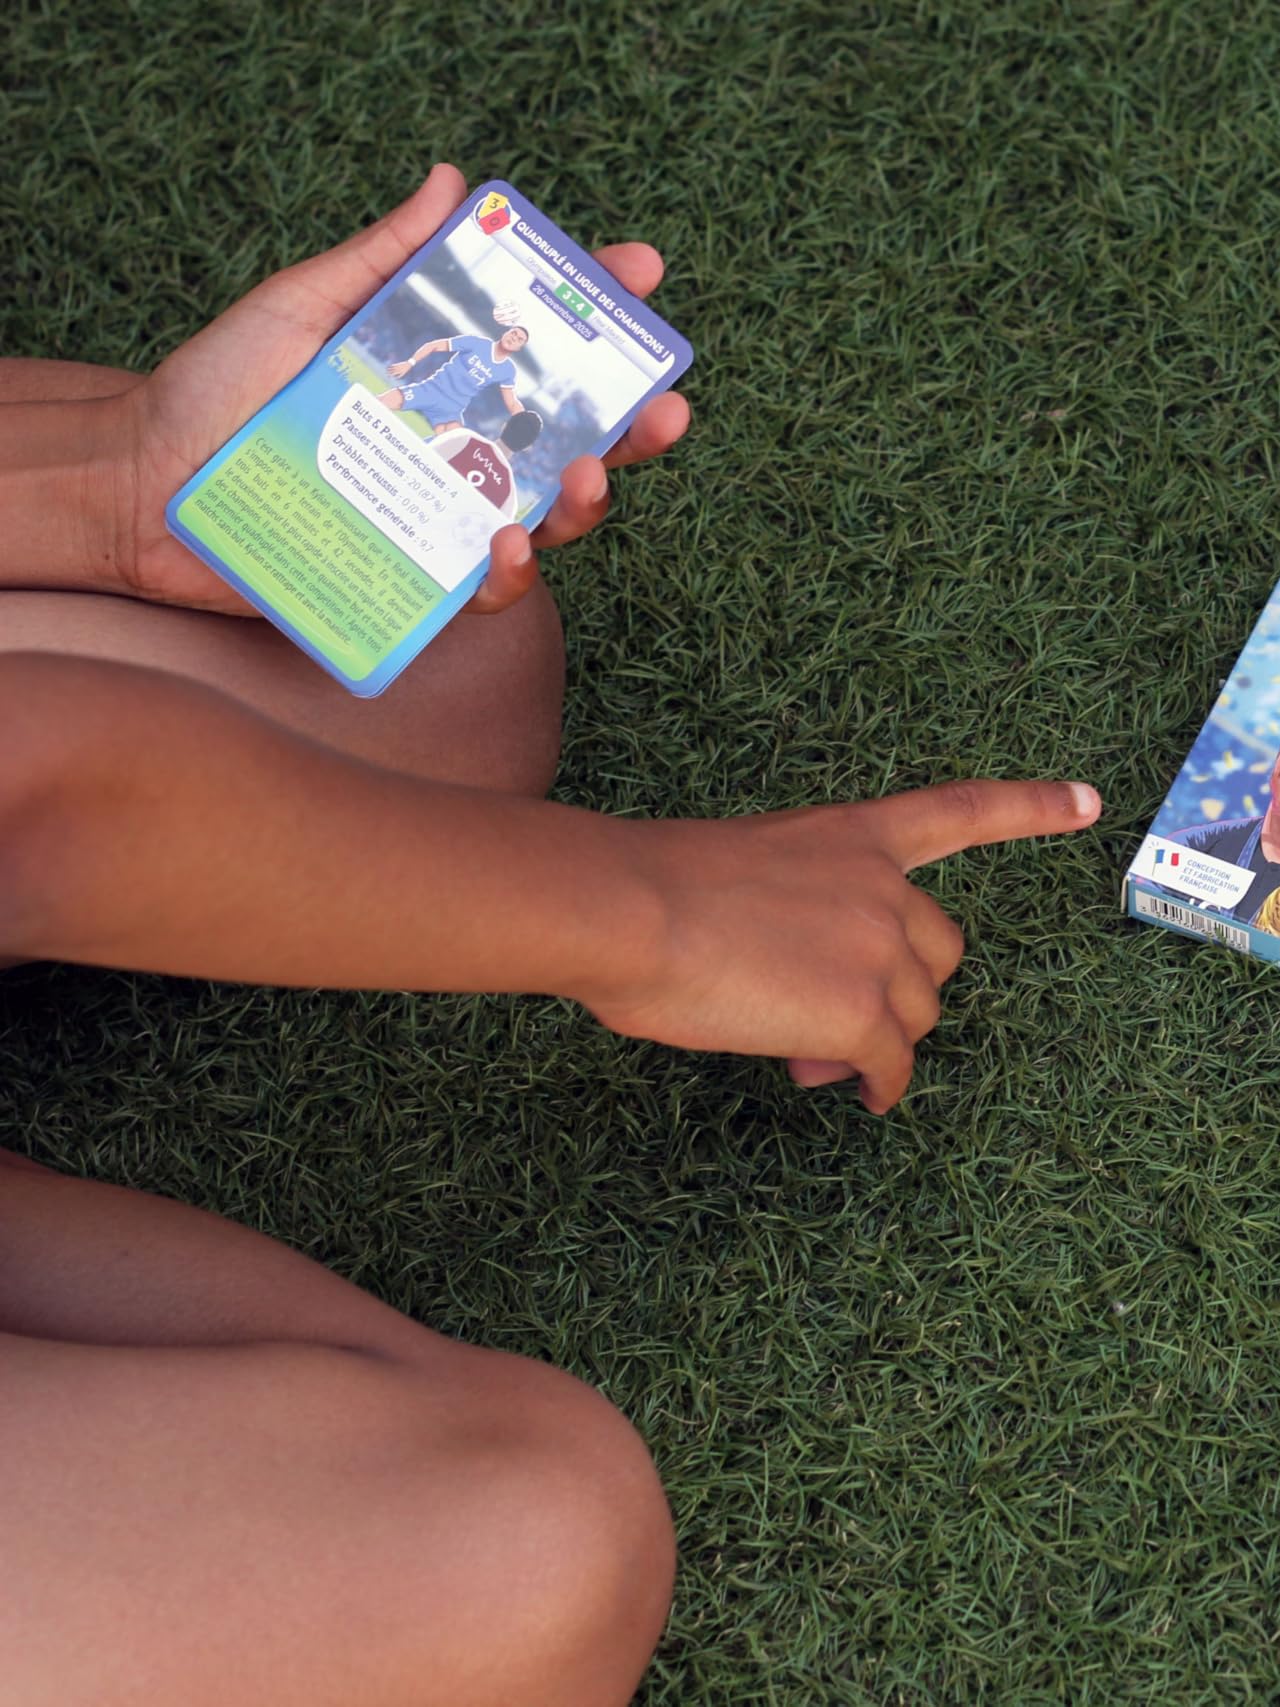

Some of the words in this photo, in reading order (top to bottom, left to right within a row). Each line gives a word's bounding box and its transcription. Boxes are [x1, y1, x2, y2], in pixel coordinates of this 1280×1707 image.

[487, 197, 501, 210] 3
[515, 218, 567, 266] QUADRUPLÉ
[561, 261, 577, 276] EN
[573, 272, 600, 297] LIGUE
[597, 292, 616, 311] DES
[612, 306, 665, 354] CHAMPIONS
[531, 283, 544, 296] 26
[541, 292, 576, 323] novembre
[572, 319, 593, 338] 2025
[561, 289, 573, 300] 3
[574, 300, 586, 312] 4
[332, 433, 371, 470] Dribbles
[367, 465, 400, 497] réussis
[341, 416, 373, 446] Passes
[369, 441, 407, 477] réussies
[351, 400, 374, 422] Buts
[371, 417, 382, 429] &
[379, 425, 411, 455] Passes
[407, 450, 448, 489] décisives
[325, 453, 381, 505] Performance
[375, 500, 417, 540] générale
[1178, 874, 1218, 893] FRANÇAISE
[1182, 867, 1193, 875] ET
[1192, 871, 1239, 892] FABRICATION
[1185, 859, 1231, 880] CONCEPTION
